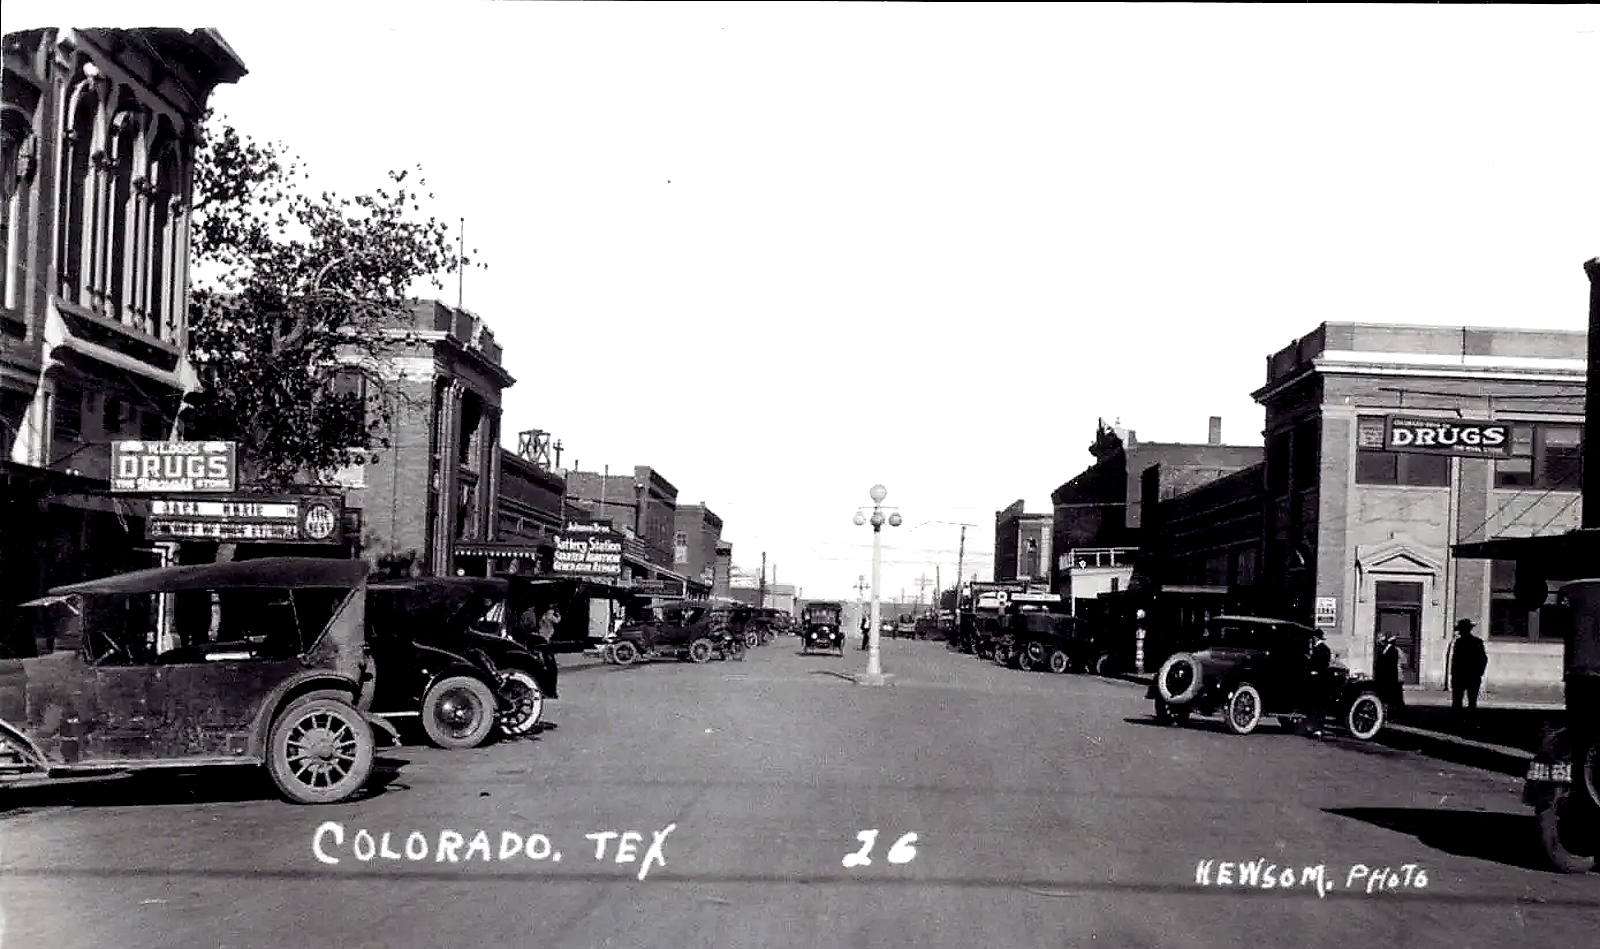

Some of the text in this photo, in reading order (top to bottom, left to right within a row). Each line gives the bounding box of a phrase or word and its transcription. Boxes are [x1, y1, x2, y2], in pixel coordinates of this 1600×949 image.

[1391, 427, 1505, 445] DRUGS
[119, 455, 228, 478] DRUGS
[589, 536, 622, 553] Station
